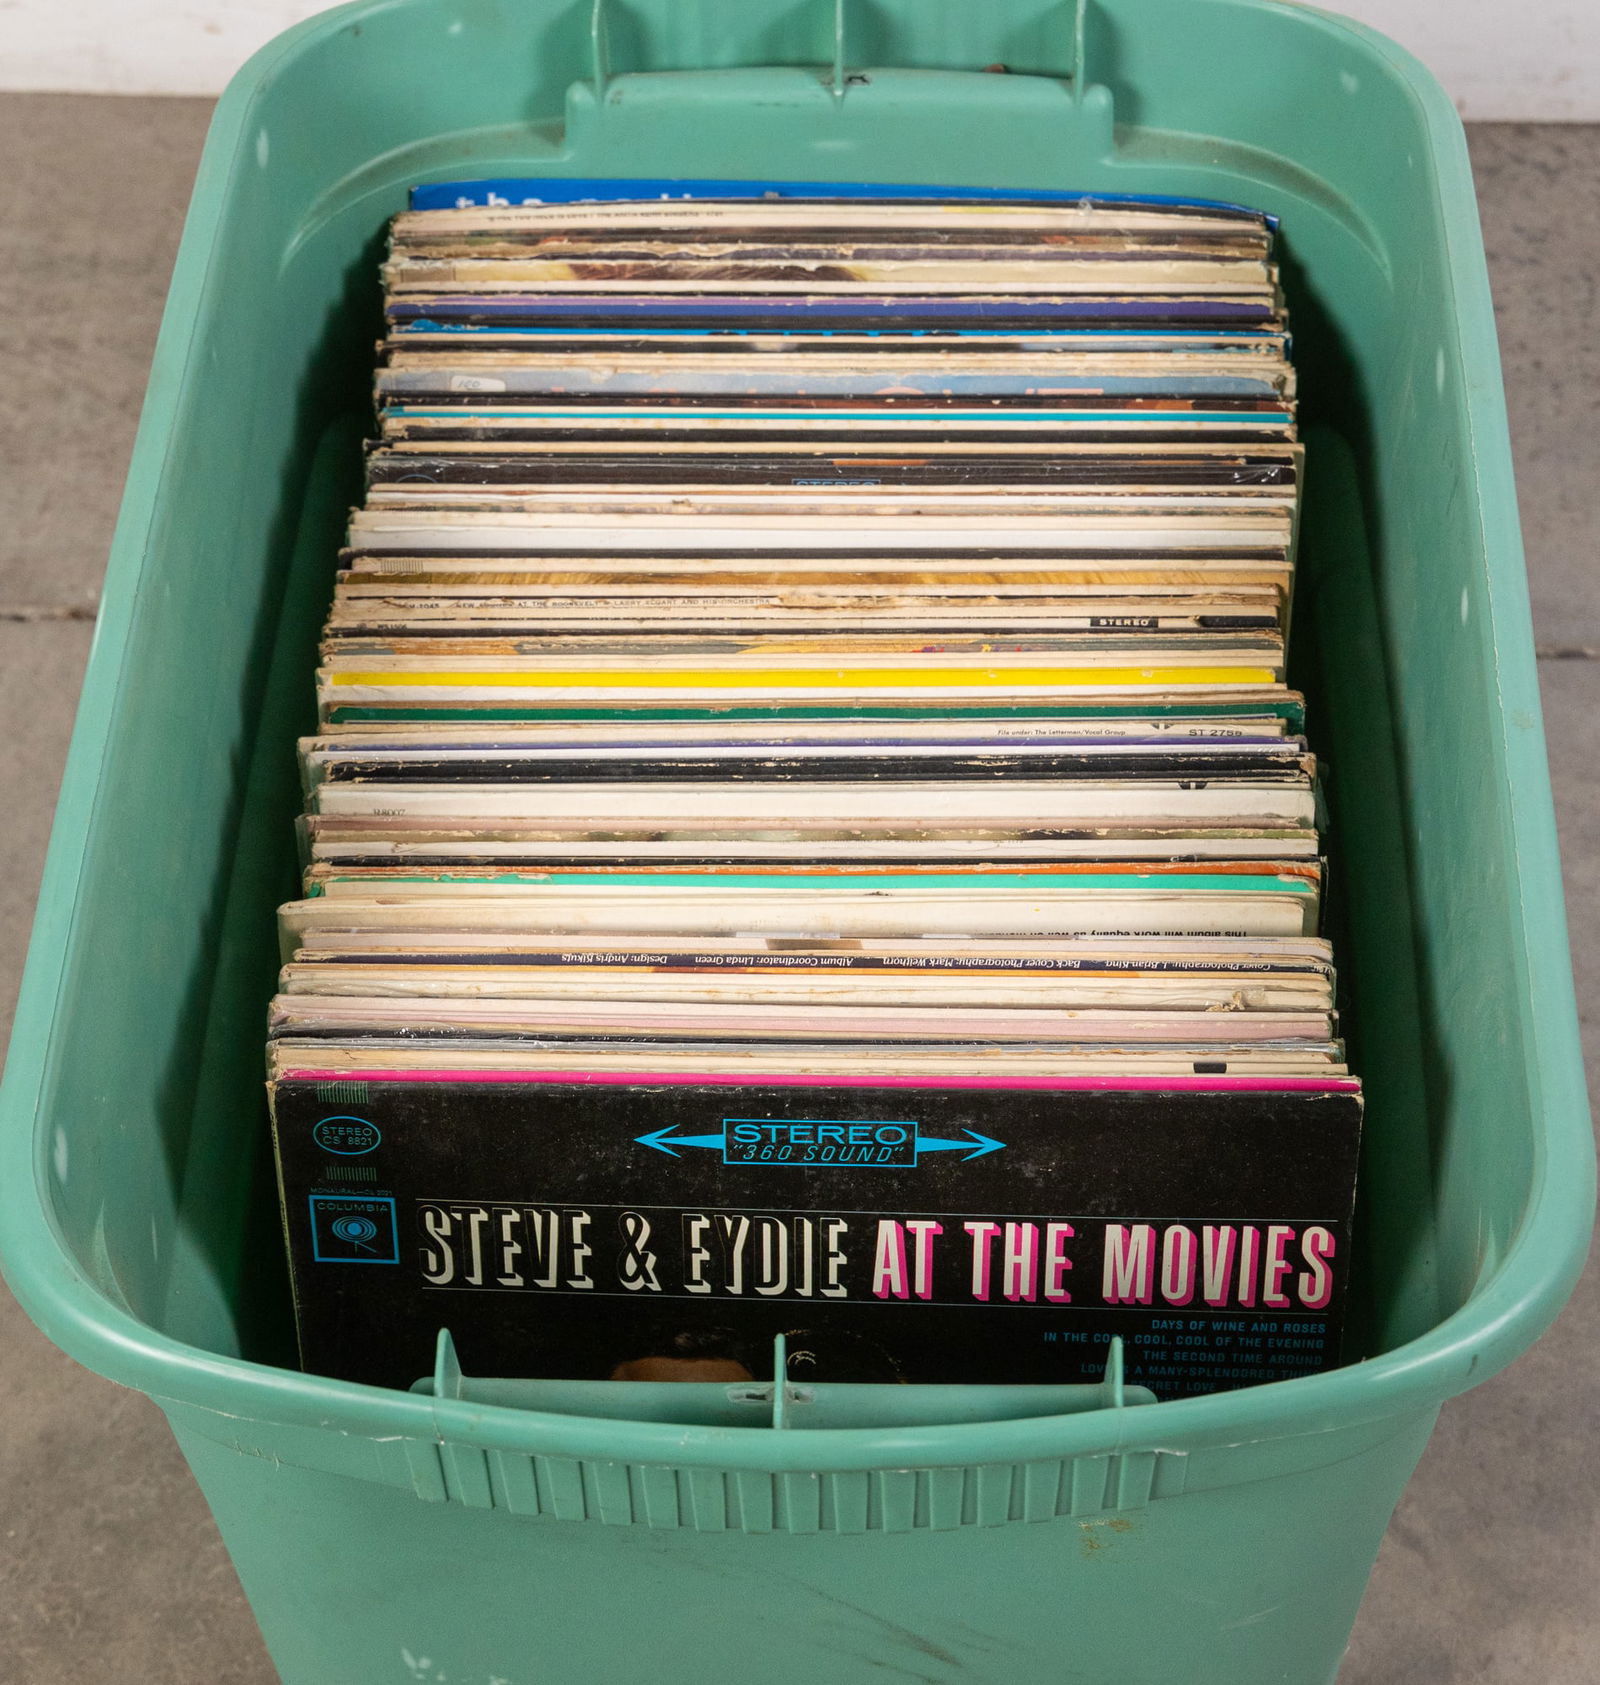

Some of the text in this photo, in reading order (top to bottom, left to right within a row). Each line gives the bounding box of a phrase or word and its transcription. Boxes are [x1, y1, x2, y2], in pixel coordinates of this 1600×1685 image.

[1099, 618, 1149, 626] STEREO
[1105, 729, 1126, 737] Group
[1188, 728, 1205, 737] ST
[630, 954, 668, 964] Design:
[695, 956, 724, 965] Green
[725, 956, 754, 966] Linda
[756, 956, 819, 966] Coordinator:
[820, 957, 854, 967] Album
[928, 957, 954, 967] Mark
[1025, 959, 1055, 968] Cover
[1057, 960, 1081, 969] Back
[321, 1126, 373, 1136] STEREO
[733, 1123, 907, 1147] STEREO
[322, 1135, 372, 1146] CS 8821
[803, 1145, 905, 1162] SOUND"
[316, 1201, 389, 1212] COLUMBIA
[416, 1204, 1336, 1309] STEVE & EYDIE AT THE MOVIES
[1151, 1319, 1327, 1334] DAYS OF WINE AND ROSES
[1043, 1332, 1057, 1343] IN
[1063, 1332, 1089, 1343] THE
[1134, 1334, 1172, 1346] COOL,
[1175, 1335, 1211, 1347] COOL
[1215, 1335, 1233, 1347] OF
[1237, 1337, 1263, 1348] THE
[1267, 1338, 1325, 1349] EVENING
[1143, 1350, 1323, 1366] THE SECOND TIME AROUND
[1080, 1363, 1106, 1374] LOV
[1133, 1365, 1143, 1376] A
